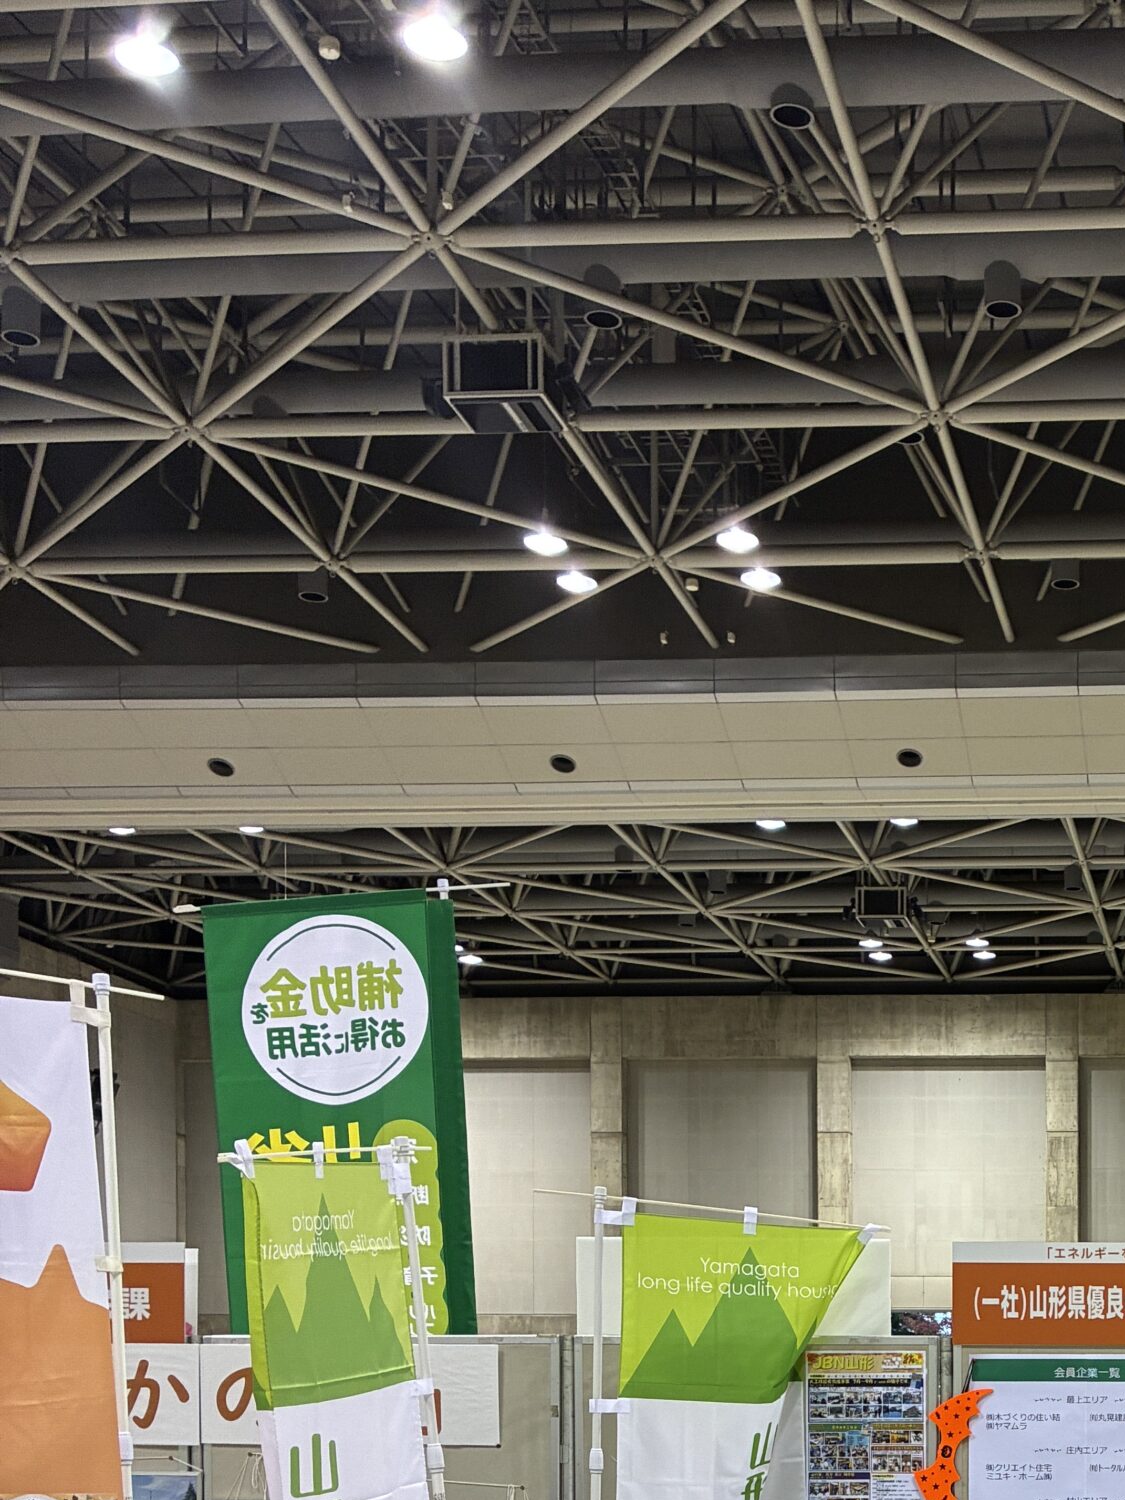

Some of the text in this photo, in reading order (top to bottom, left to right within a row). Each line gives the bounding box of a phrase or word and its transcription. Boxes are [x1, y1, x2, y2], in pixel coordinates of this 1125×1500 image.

[699, 1256, 800, 1280] Yamagata
[637, 1272, 782, 1300] long life quality
[1053, 1366, 1121, 1379] 会員企業一覧
